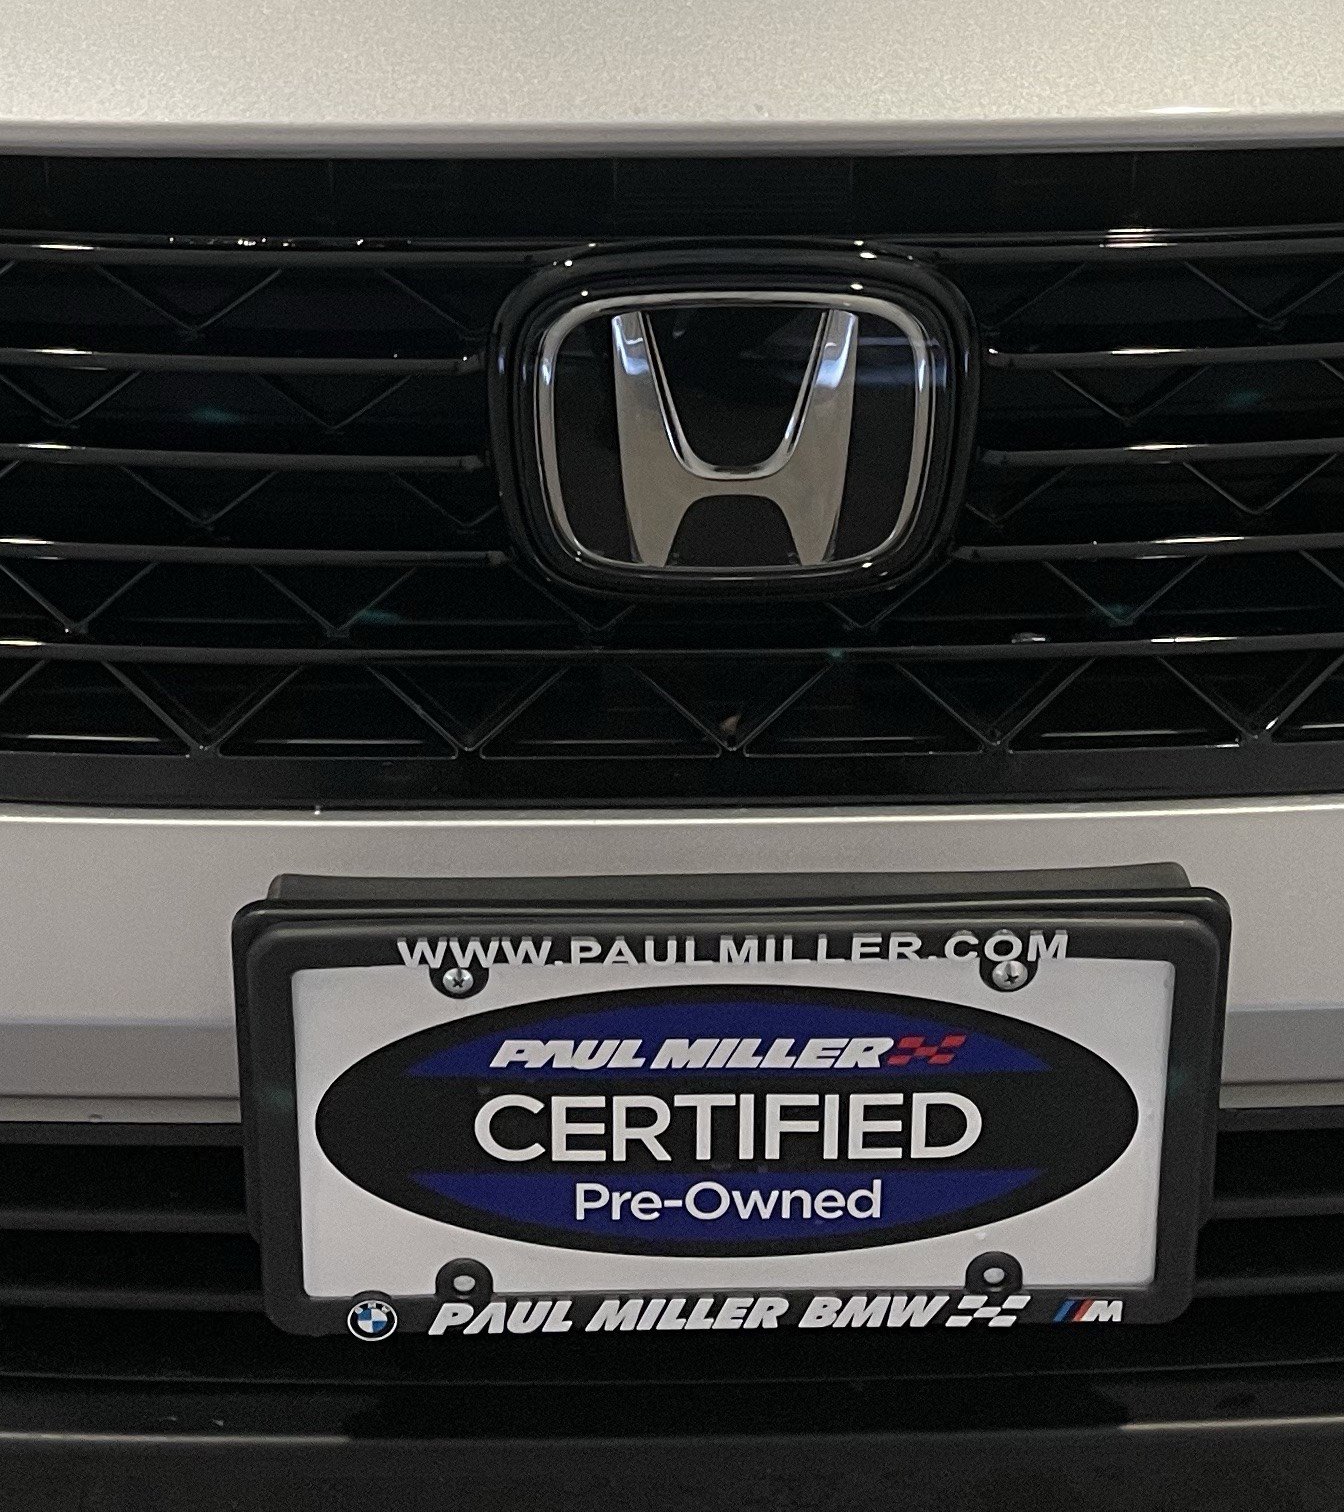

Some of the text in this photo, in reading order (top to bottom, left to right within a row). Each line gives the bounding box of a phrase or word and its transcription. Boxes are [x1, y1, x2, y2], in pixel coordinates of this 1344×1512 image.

[397, 929, 1068, 969] WWW.PAULMILLER.COM
[489, 1037, 894, 1070] PAUL MILLER
[474, 1092, 983, 1163] CERTIFIED
[574, 1179, 883, 1221] Pre-Owned
[428, 1295, 951, 1336] PAUL MILLER BMW
